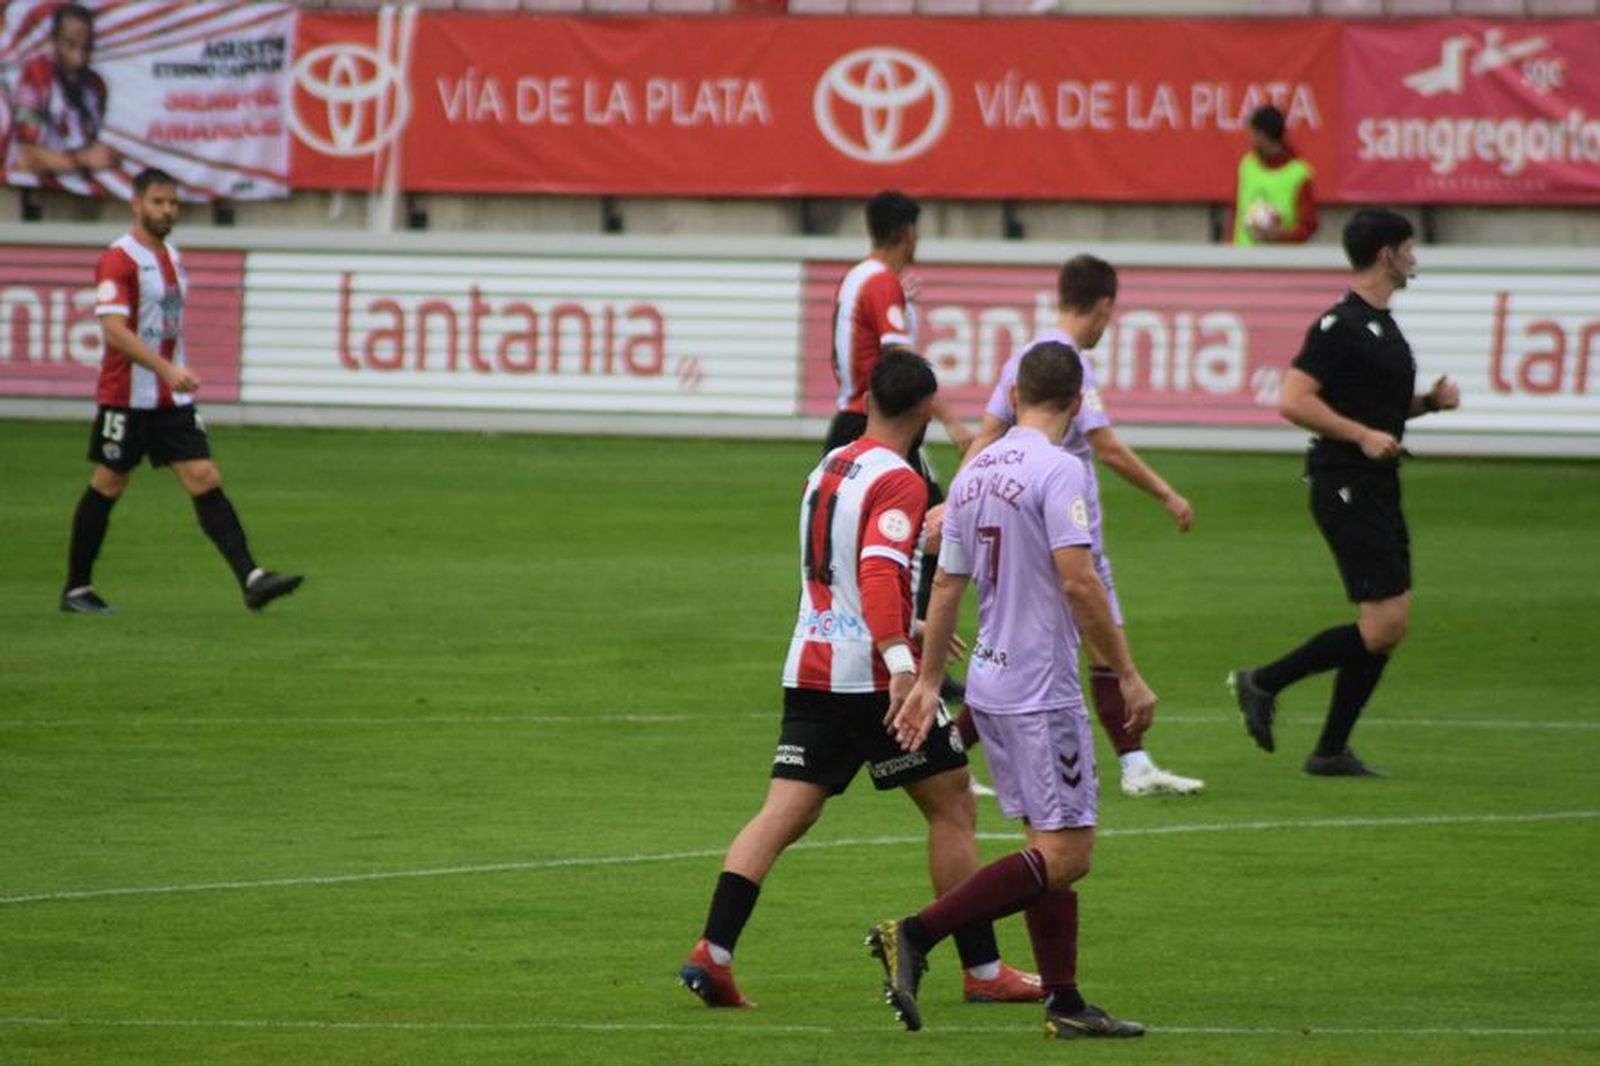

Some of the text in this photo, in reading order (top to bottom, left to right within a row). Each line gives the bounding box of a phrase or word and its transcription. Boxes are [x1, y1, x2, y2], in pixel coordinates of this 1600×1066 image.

[436, 68, 769, 126] VÍA DE LA PLATA
[974, 70, 1050, 128] VÍA
[1056, 81, 1113, 130] DE
[1125, 84, 1182, 131] LA
[338, 271, 665, 378] lantania
[102, 411, 126, 441] 15
[804, 489, 838, 586] 11
[977, 525, 1003, 590] 7
